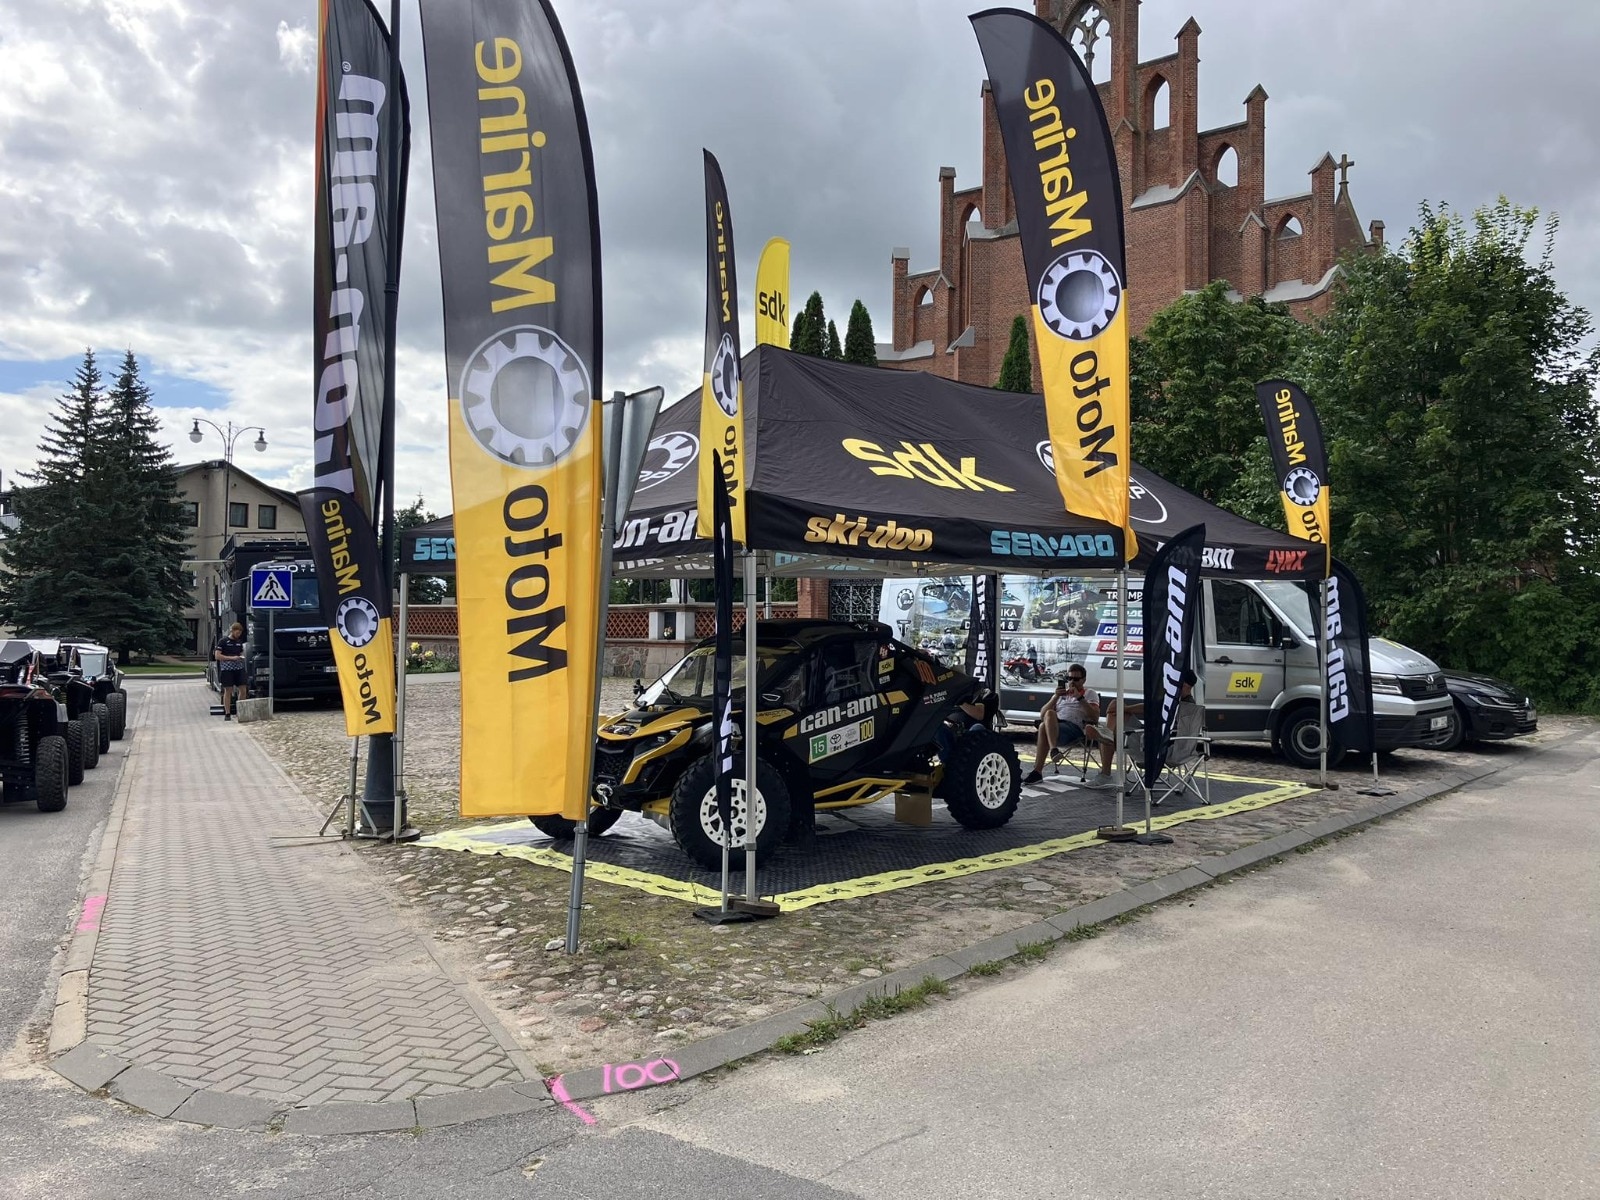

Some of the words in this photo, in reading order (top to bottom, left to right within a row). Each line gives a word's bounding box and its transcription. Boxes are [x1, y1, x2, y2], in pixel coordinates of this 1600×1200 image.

[759, 290, 786, 327] sdk
[841, 438, 1016, 492] sdk
[804, 513, 934, 551] ski-doo
[1265, 550, 1307, 573] LYNX
[1235, 677, 1255, 688] sdk
[800, 694, 878, 734] can-am
[860, 720, 873, 741] 100
[813, 740, 825, 754] 15
[603, 1058, 680, 1093] 100
